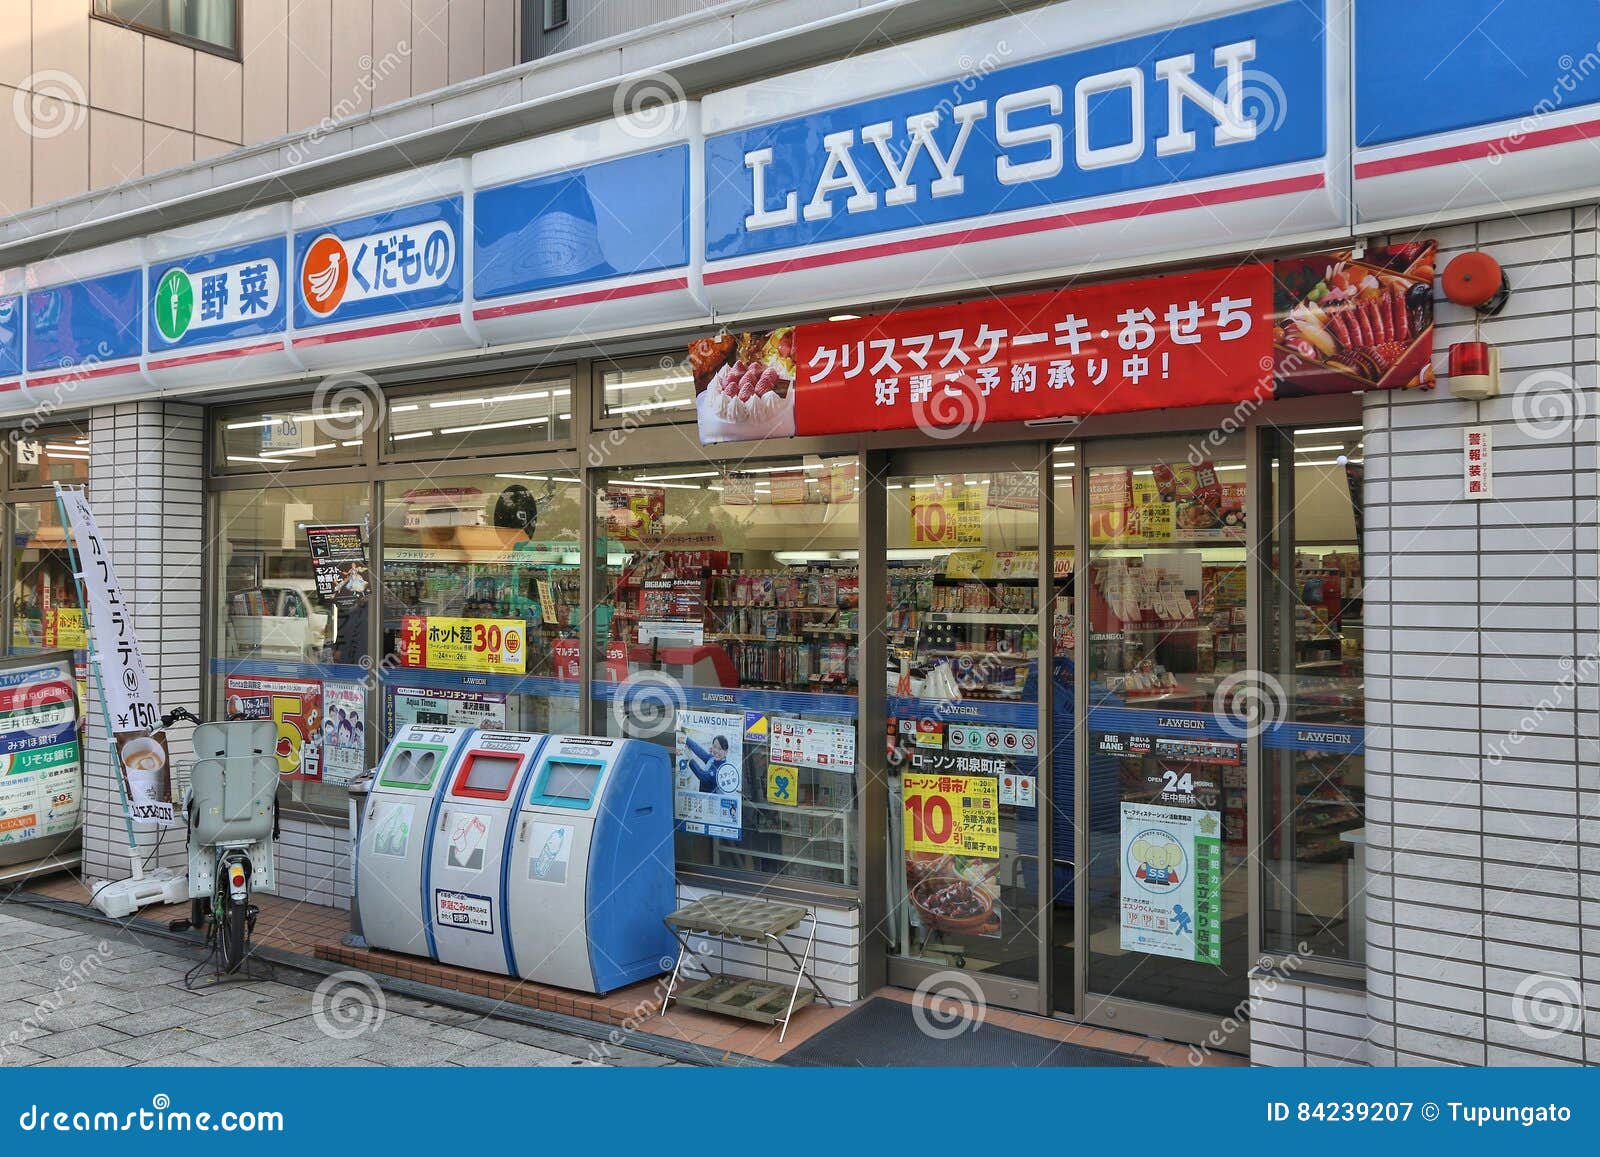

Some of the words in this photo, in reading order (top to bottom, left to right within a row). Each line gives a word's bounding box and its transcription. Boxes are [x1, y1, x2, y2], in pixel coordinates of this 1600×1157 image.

[744, 39, 1257, 232] LAWSON
[351, 229, 449, 294] くだもの
[200, 262, 270, 321] 野菜
[807, 295, 1254, 384] クリスマスケーキ・おせち
[1469, 432, 1481, 492] 警報装置
[407, 618, 421, 664] 予告
[429, 625, 472, 643] ホット麺
[473, 623, 502, 653] 30
[463, 677, 487, 686] LAWSON
[702, 692, 735, 703] LAWSON
[939, 705, 978, 715] LAWSON
[693, 714, 728, 727] LAWSON
[1158, 717, 1205, 729] LAWSON
[7, 733, 58, 751] みずほ銀行
[1100, 742, 1123, 751] BANG
[1104, 734, 1119, 743] BIG
[1297, 731, 1352, 744] LAWSON
[22, 748, 74, 766] りそな銀行
[912, 754, 1006, 774] ローソン和泉町店
[1163, 770, 1194, 794] 24
[1161, 793, 1196, 804] 年中無休
[905, 794, 953, 845] 10
[1149, 868, 1165, 878] SS
